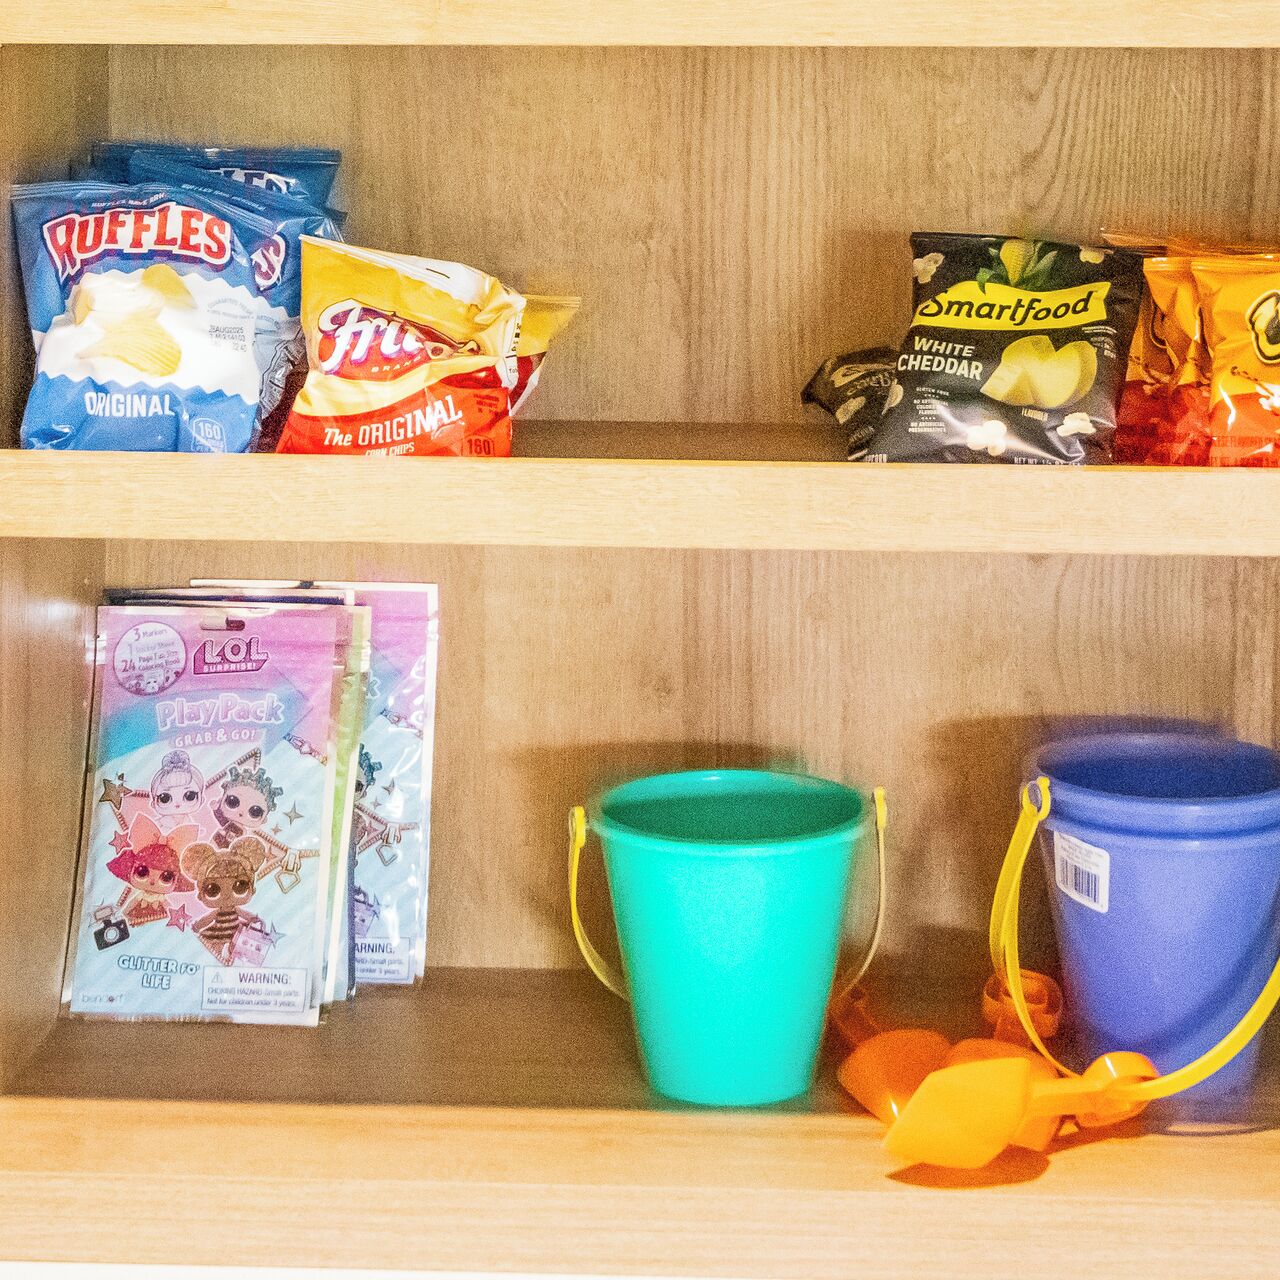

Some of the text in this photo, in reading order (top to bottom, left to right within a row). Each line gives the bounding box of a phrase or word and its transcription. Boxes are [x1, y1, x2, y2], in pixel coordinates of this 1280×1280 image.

[44, 202, 232, 280] RUFFLES
[919, 290, 1096, 327] Smartfood
[913, 335, 976, 357] WHITE
[897, 354, 984, 381] CHEDDAR
[84, 391, 176, 418] ORIGINAL
[197, 422, 221, 438] 160
[323, 395, 463, 446] The ORIGINAL
[466, 439, 491, 454] 160
[132, 628, 142, 641] 3
[121, 658, 137, 672] 24
[156, 692, 286, 732] Play Pack
[175, 729, 257, 747] GRAB & GO!
[117, 954, 179, 973] GLITTER
[140, 975, 172, 991] LIFE
[238, 971, 293, 986] WARNING:
